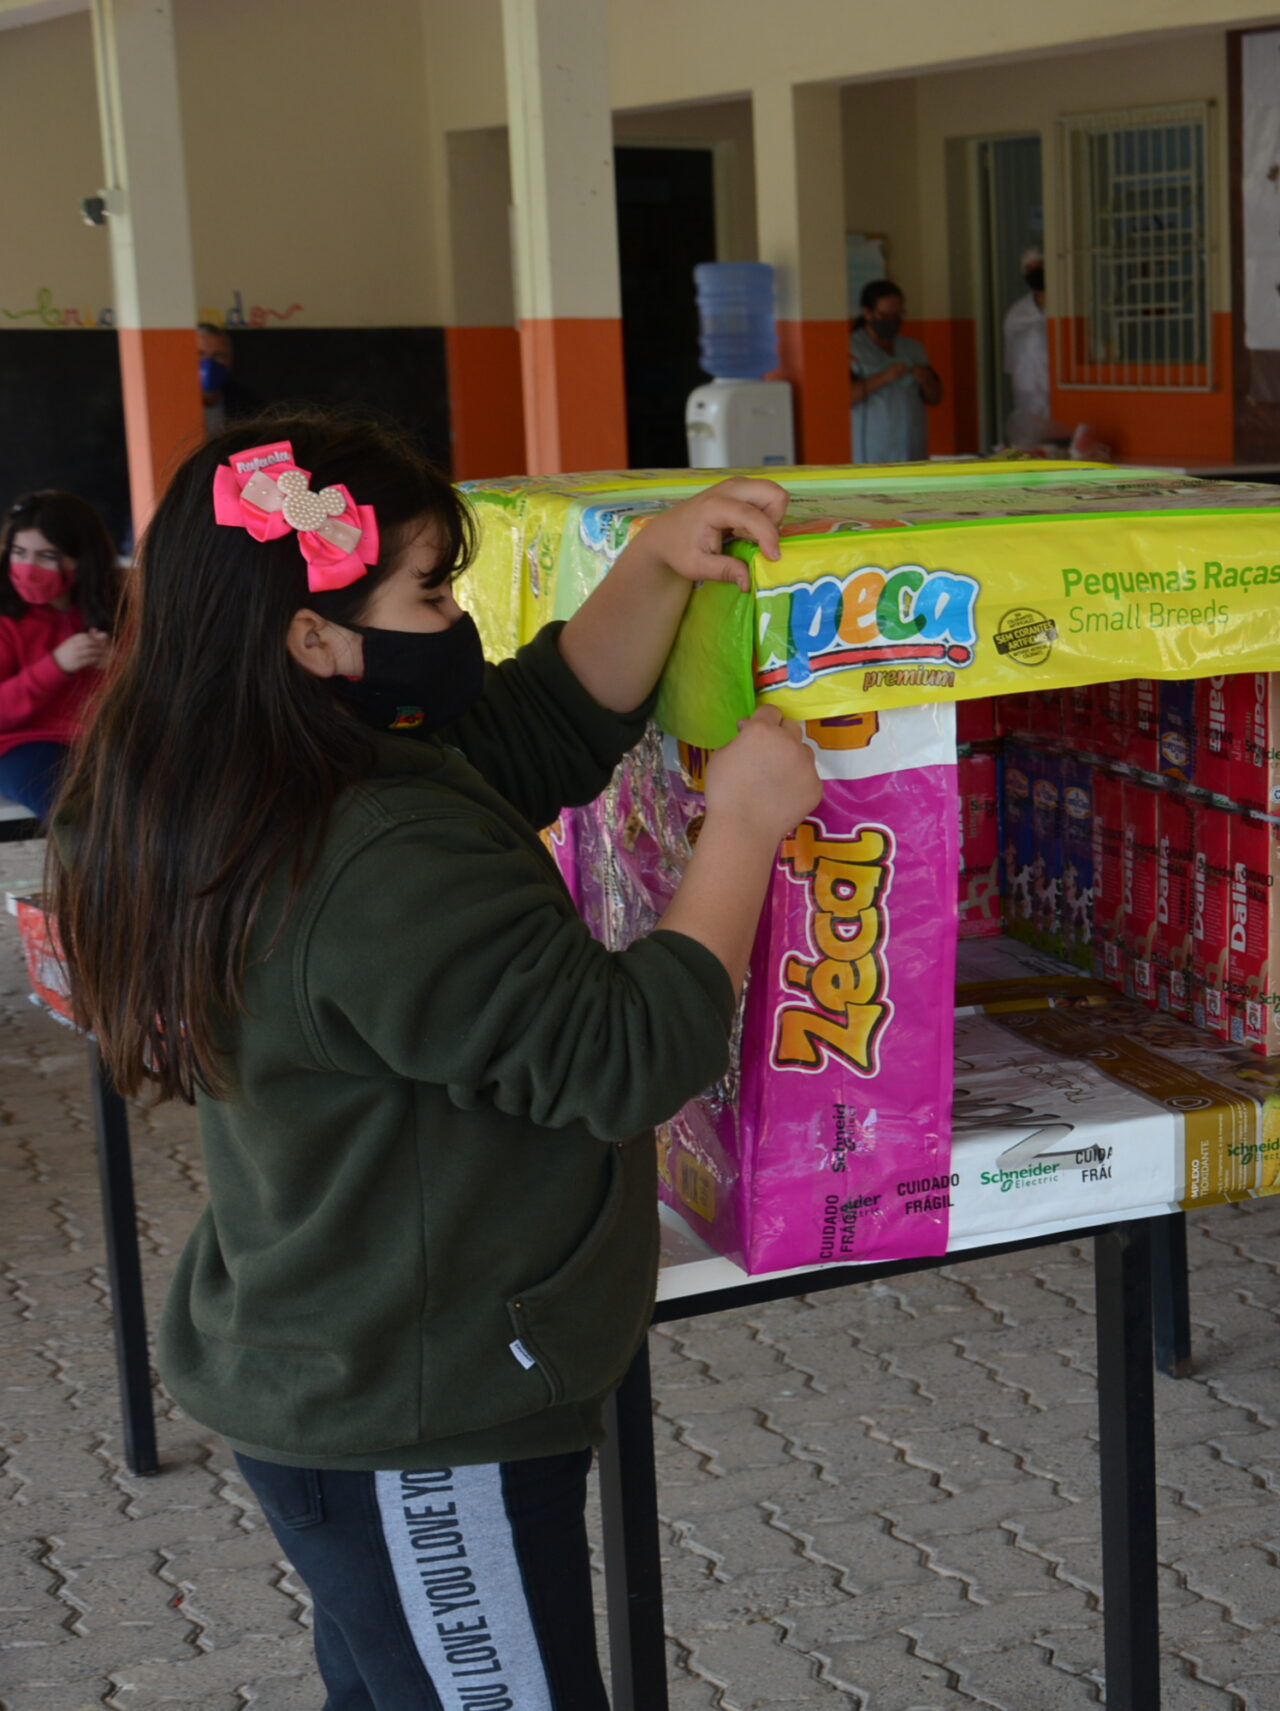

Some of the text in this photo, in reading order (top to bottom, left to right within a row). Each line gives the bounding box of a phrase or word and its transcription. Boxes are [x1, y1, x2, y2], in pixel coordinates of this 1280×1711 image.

[1061, 567, 1197, 600] Pequenas
[1068, 602, 1142, 634] Small
[1148, 599, 1230, 629] Breeds
[862, 666, 956, 692] premium
[775, 819, 892, 1075] Zécat
[896, 1173, 960, 1197] CUIDADO
[980, 1162, 1061, 1186] Schneider
[1015, 1174, 1059, 1189] Electric
[904, 1193, 955, 1215] FRÁGIL
[819, 1194, 839, 1259] CUIDADO
[404, 1502, 467, 1563] LOVE
[420, 1566, 480, 1617] YOU
[437, 1616, 502, 1677] LOVE
